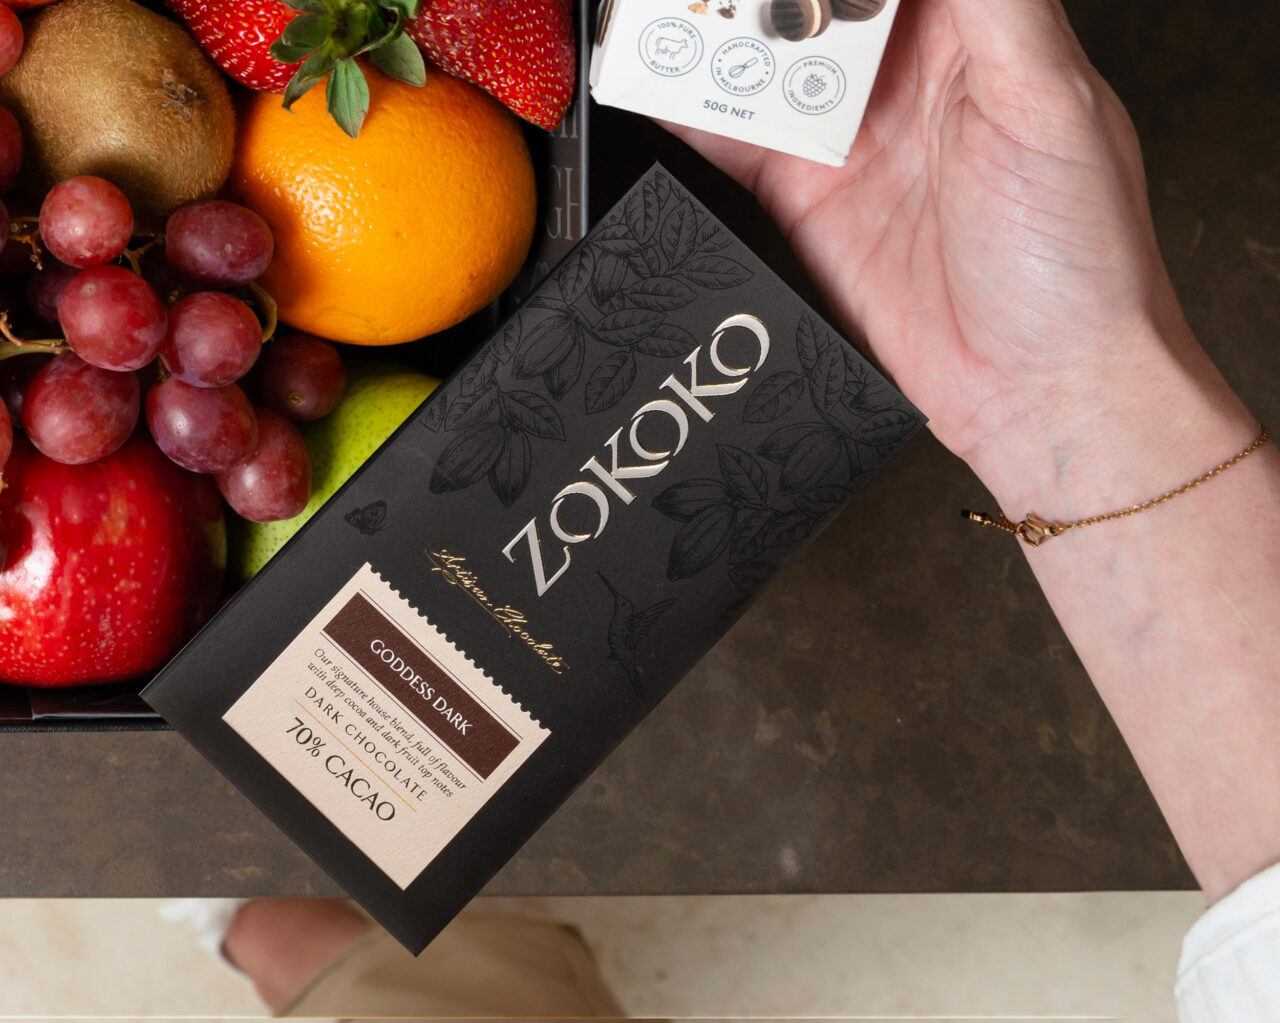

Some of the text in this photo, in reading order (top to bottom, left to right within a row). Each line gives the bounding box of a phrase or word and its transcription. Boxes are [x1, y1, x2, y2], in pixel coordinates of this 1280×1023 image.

[657, 22, 696, 40] 100% PURE
[721, 41, 771, 67] HANDCRAFTED
[650, 60, 680, 73] BUTTER
[720, 77, 766, 93] MELBOURNE
[803, 60, 838, 75] PREMIUM
[703, 99, 755, 121] 50G NET
[788, 89, 834, 111] INGREDIENTS
[502, 313, 770, 597] ZOKOKO
[426, 549, 569, 674] Artisan Chocolate
[370, 639, 473, 736] GODDESS DARK
[305, 687, 428, 802] DARK CHOCOLATE
[307, 662, 454, 798] with deep cocoa and dark fruit top notes
[314, 648, 467, 791] Our signature house blend, full of flavour
[286, 717, 396, 821] 70% CACAO
